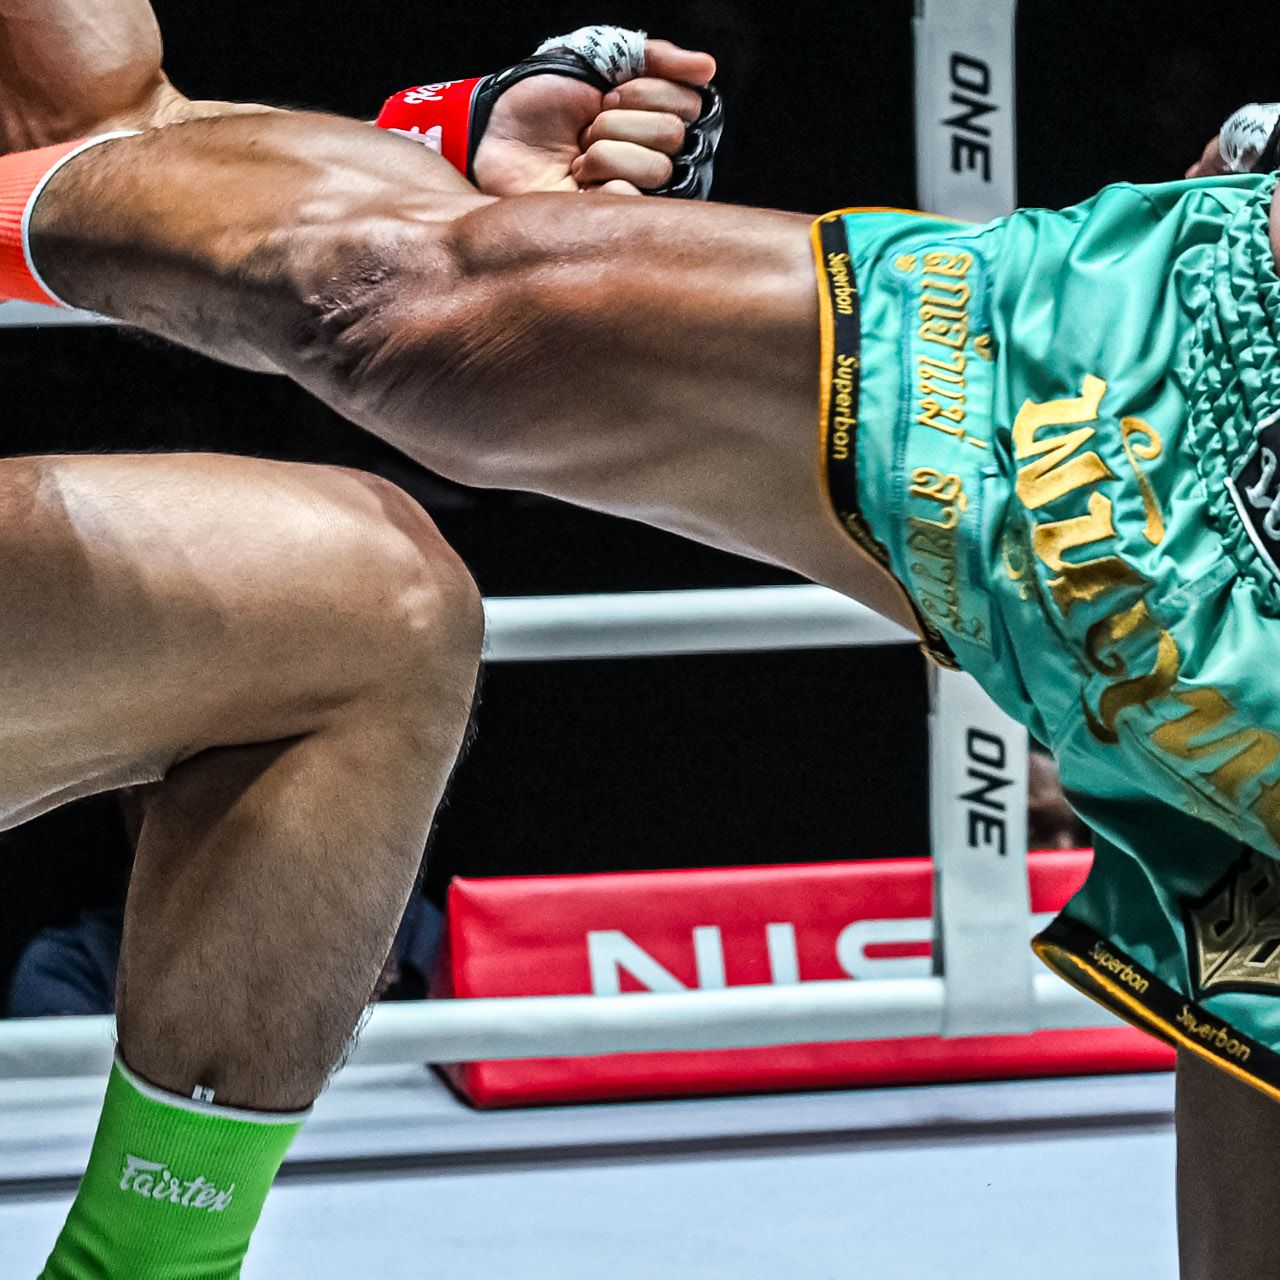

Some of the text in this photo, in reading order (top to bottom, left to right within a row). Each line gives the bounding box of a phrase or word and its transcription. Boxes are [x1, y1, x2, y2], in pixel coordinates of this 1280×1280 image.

[941, 52, 999, 184] ONE
[828, 252, 857, 315] Superbon
[831, 353, 859, 460] Superbon
[958, 727, 1019, 857] ONE
[1087, 941, 1149, 995] Superbon
[1176, 1003, 1252, 1063] Superbon
[120, 1153, 237, 1213] Fairtex
